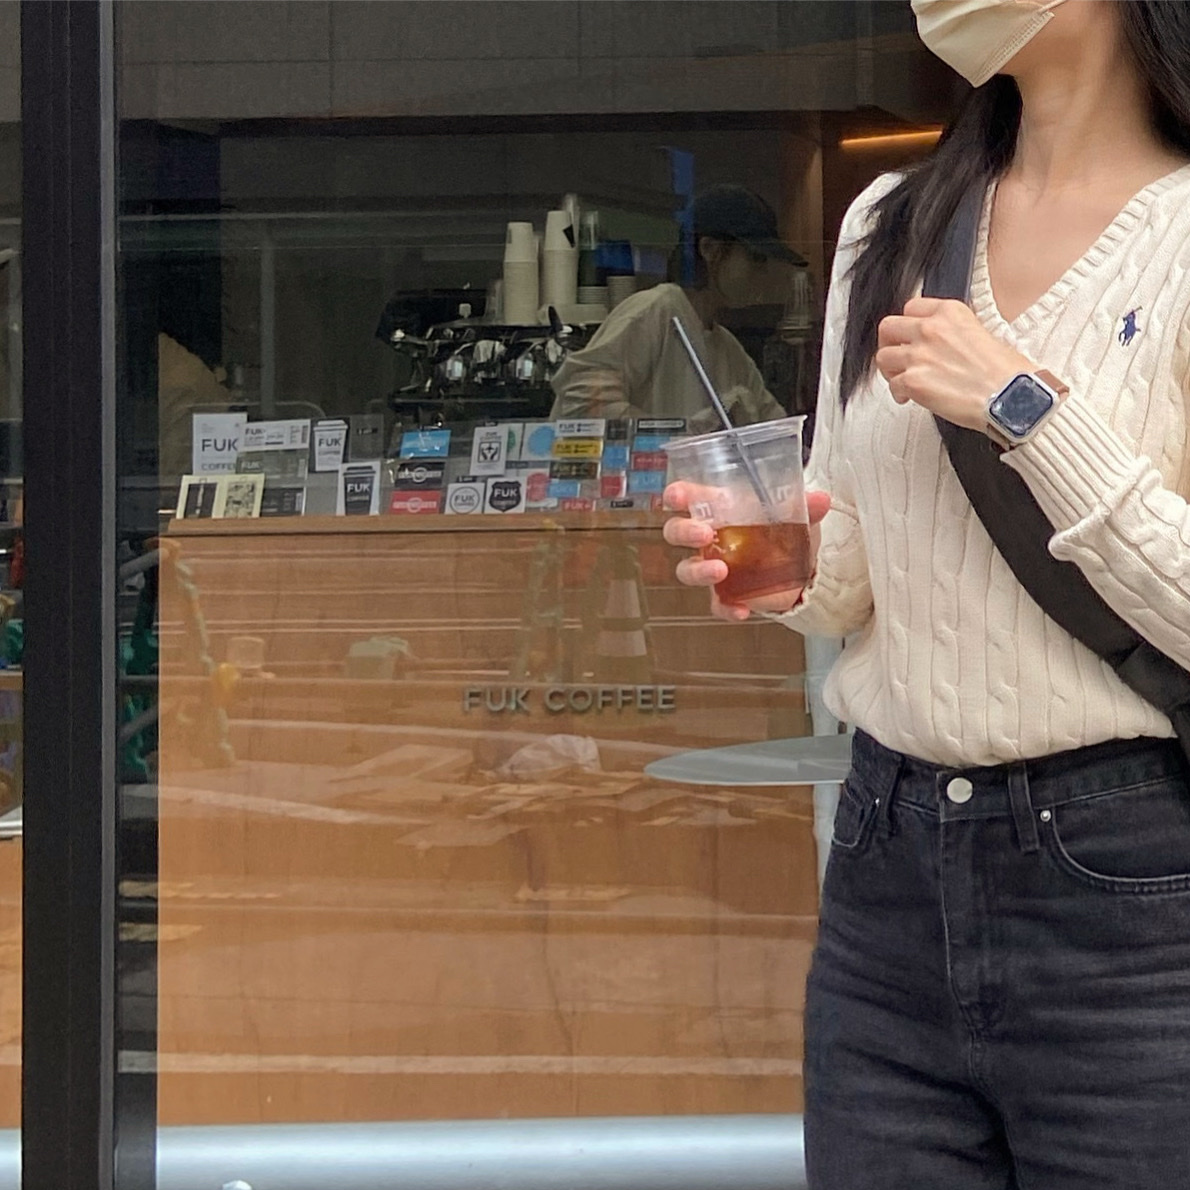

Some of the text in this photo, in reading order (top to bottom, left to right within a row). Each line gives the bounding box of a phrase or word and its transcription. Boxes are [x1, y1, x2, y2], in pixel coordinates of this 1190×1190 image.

[201, 438, 239, 452] FUK
[318, 437, 342, 447] FUK
[347, 483, 371, 492] FUK
[494, 488, 518, 497] FUK
[454, 494, 475, 503] FUK
[464, 685, 677, 711] FUK COFFEE
